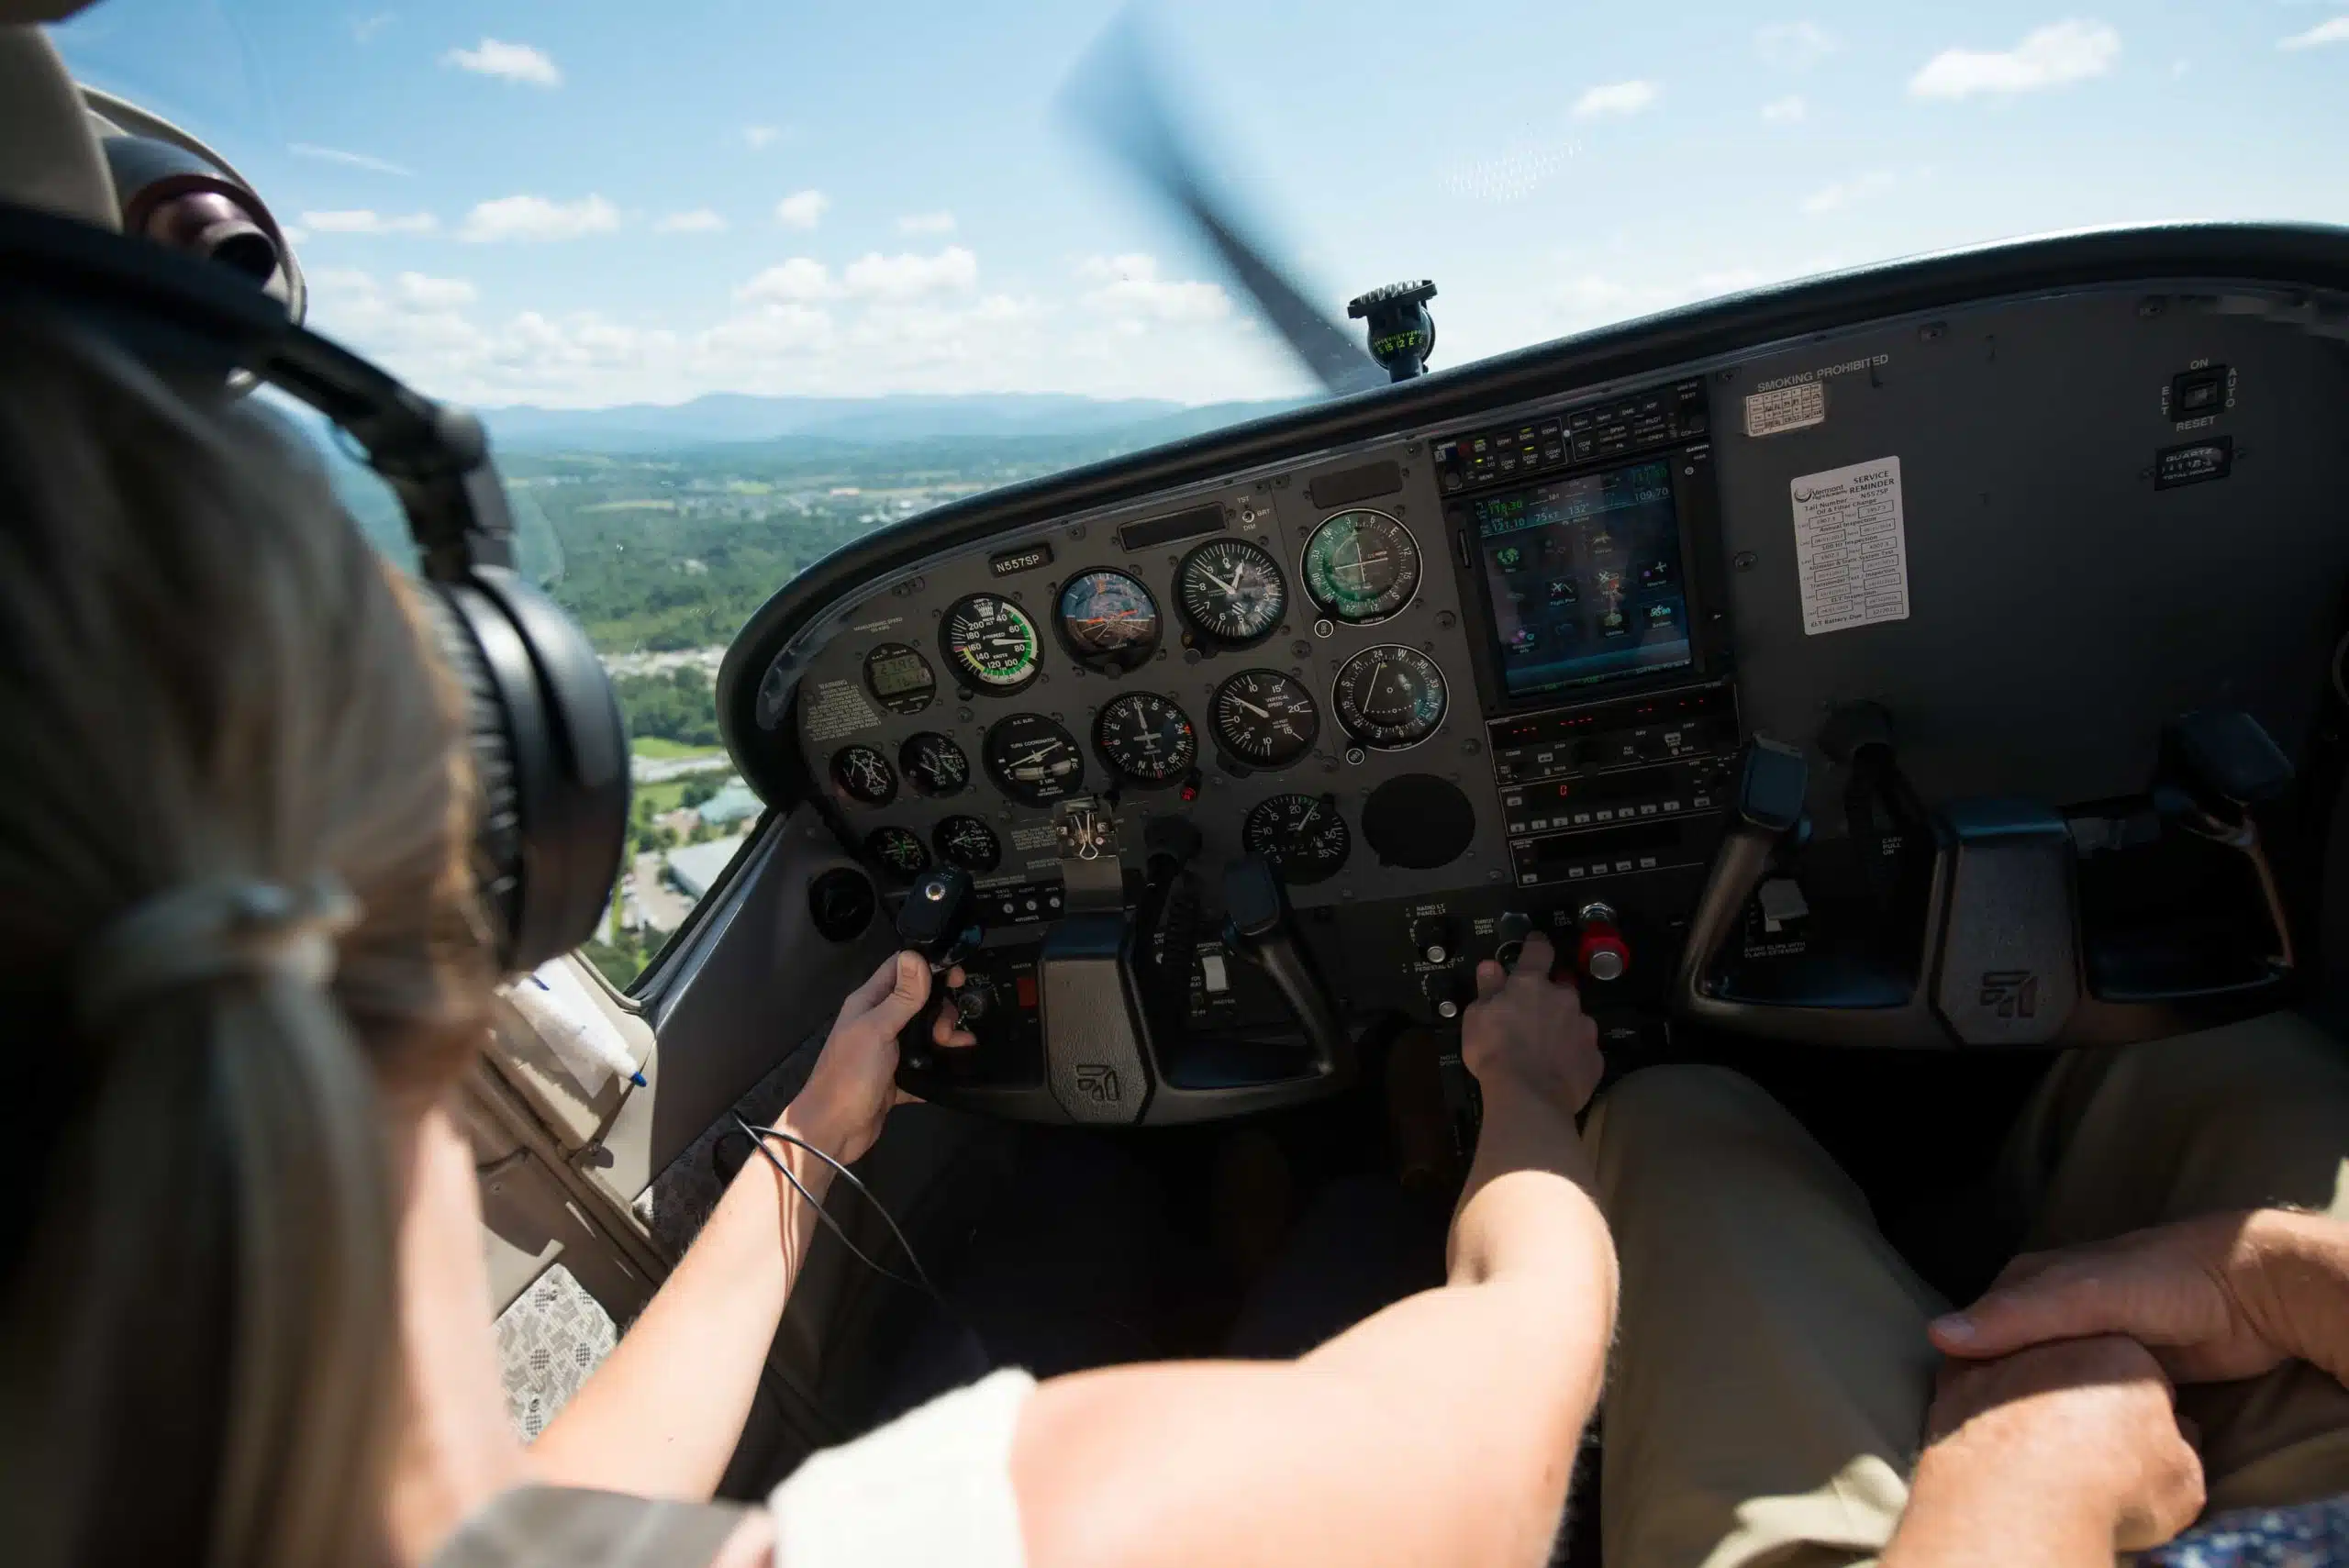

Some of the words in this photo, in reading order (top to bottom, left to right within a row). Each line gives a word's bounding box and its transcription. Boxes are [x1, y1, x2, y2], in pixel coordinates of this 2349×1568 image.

[1409, 337, 1415, 345] E
[2189, 358, 2210, 370] ON
[1757, 372, 1813, 393] SMOKING
[1817, 354, 1888, 379] PROHIBITED
[2224, 367, 2239, 407] AUTO
[2176, 415, 2217, 433] RESET
[1686, 443, 1710, 453] GARMIN
[1854, 470, 1890, 484] SERVICE
[1811, 484, 1844, 496] Vermont
[1850, 478, 1894, 494] REMINDER
[1237, 495, 1250, 504] TST
[1635, 487, 1670, 503] 109.70
[1820, 497, 1848, 508] Number
[1243, 523, 1256, 531] DIM
[1391, 527, 1399, 536] E
[1323, 527, 1332, 538] N
[1312, 549, 1319, 560] 33
[996, 554, 1040, 573] N557SP
[1207, 565, 1213, 574] 9
[1255, 567, 1264, 575] 2
[1312, 573, 1321, 584] 30
[1403, 571, 1411, 580] 15
[1198, 583, 1207, 591] 8
[1263, 593, 1270, 601] 3
[1371, 604, 1380, 612] 21
[996, 614, 1008, 623] 40
[1219, 613, 1226, 621] 6
[1237, 615, 1244, 624] 5
[968, 622, 984, 631] 200
[966, 631, 980, 640] 180
[967, 643, 982, 651] 160
[1014, 644, 1026, 652] 80
[976, 651, 991, 661] 140
[1373, 650, 1384, 659] 24
[1397, 648, 1408, 658] W
[987, 661, 1002, 669] 120
[1005, 659, 1019, 668] 100
[1353, 661, 1363, 670] 21
[1417, 659, 1428, 670] 30
[1430, 679, 1439, 689] 33
[1249, 684, 1259, 694] 10
[1272, 684, 1281, 694] 15
[1288, 705, 1300, 714] 20
[1341, 700, 1351, 710] 15
[1430, 701, 1439, 709] N
[1118, 708, 1129, 717] 12
[1165, 710, 1176, 719] 21
[1111, 723, 1120, 731] E
[1353, 717, 1364, 728] 12
[1174, 723, 1186, 734] 24
[1284, 727, 1293, 735] 15
[1244, 731, 1252, 740] 5
[1375, 729, 1382, 739] E
[1010, 741, 1024, 751] TURN
[1024, 738, 1057, 748] COORDINATOR
[1176, 740, 1186, 751] W
[1263, 737, 1272, 745] 10
[1167, 752, 1180, 763] 30
[1072, 762, 1079, 771] R
[1138, 760, 1147, 769] N
[1288, 806, 1301, 815] 20
[1270, 813, 1279, 821] 15
[1310, 811, 1321, 820] 25
[1263, 826, 1274, 837] 10
[1325, 830, 1336, 840] 30
[1318, 849, 1330, 859] 35
[1417, 908, 1437, 917] PANEL
